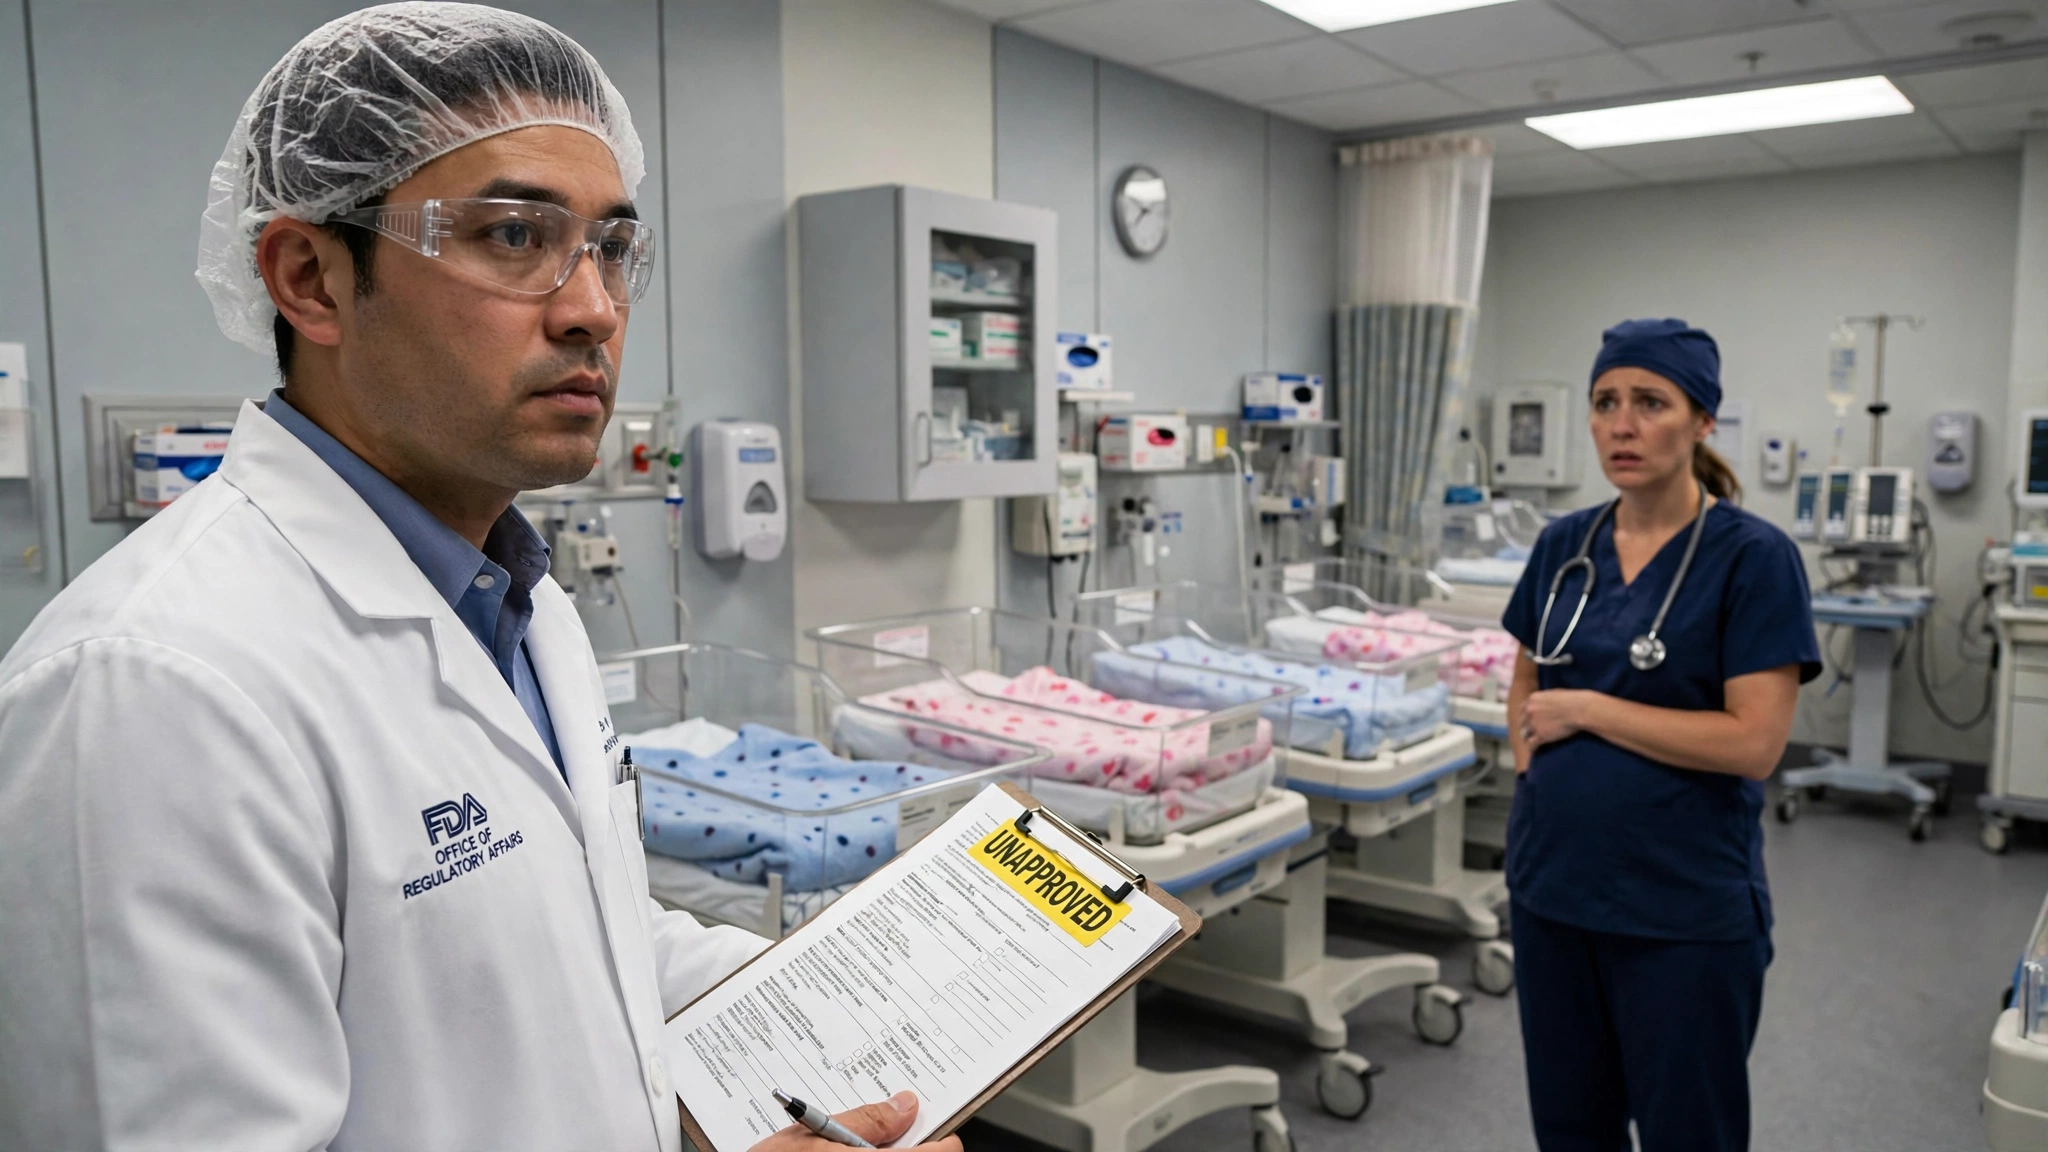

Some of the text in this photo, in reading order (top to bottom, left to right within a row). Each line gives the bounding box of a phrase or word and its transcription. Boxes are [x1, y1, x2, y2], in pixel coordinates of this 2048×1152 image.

[421, 792, 488, 846] FDA
[435, 827, 492, 865] OFFICE OF
[402, 830, 524, 899] REGULATORY AFFAIRS
[983, 829, 1113, 932] UNAPPROVED
